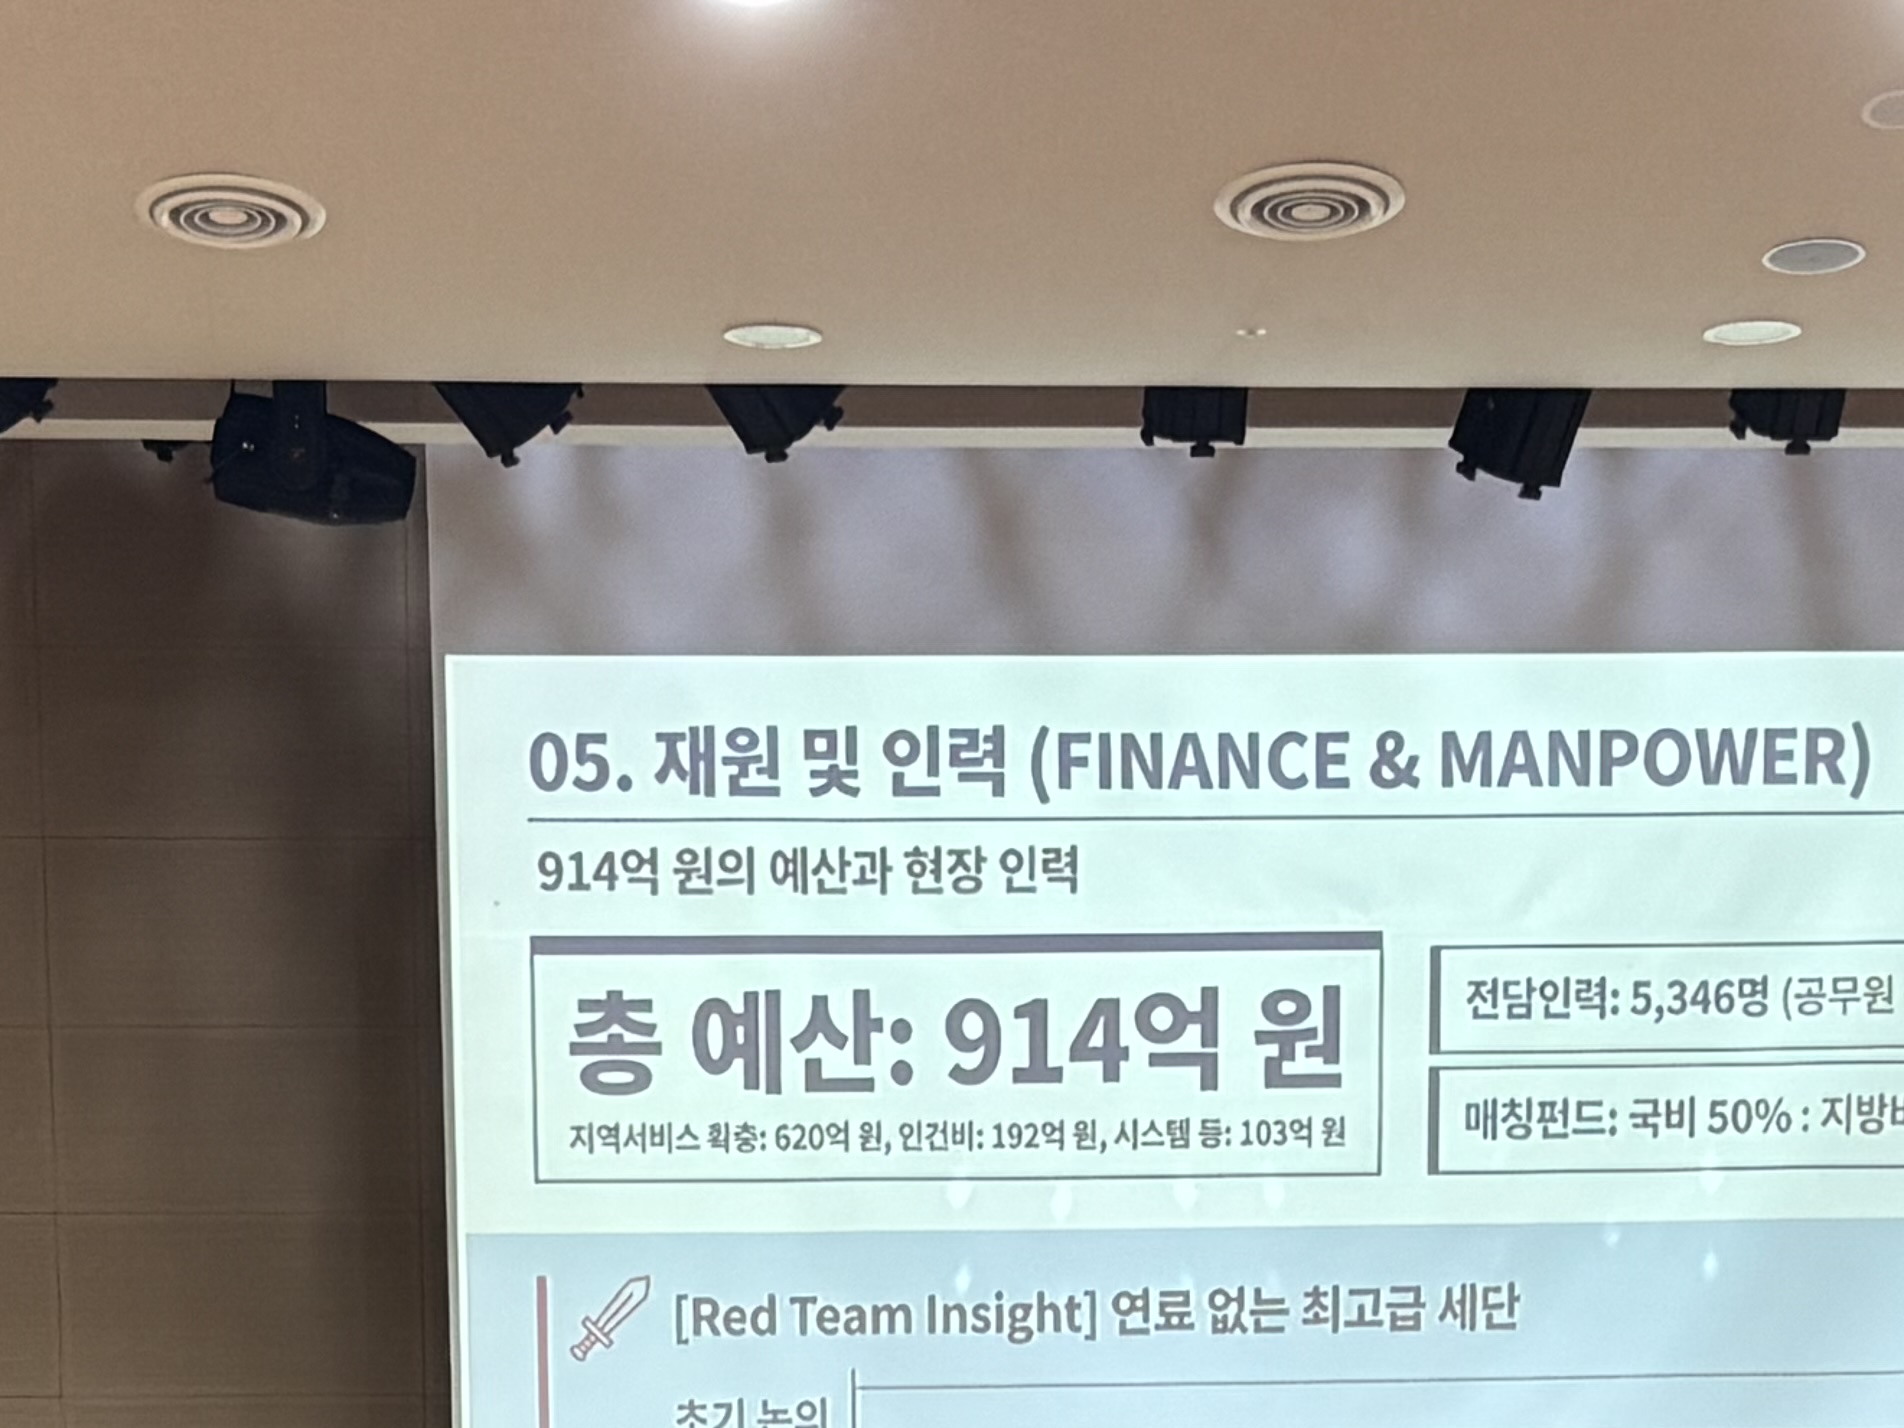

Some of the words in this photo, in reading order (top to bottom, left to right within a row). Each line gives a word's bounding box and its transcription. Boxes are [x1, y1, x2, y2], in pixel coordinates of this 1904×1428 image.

[529, 731, 633, 793] 05.
[653, 724, 782, 799] 재원
[803, 724, 861, 799] 및
[882, 724, 1006, 798] 인력
[1030, 724, 1351, 805] (FINANCE
[1369, 729, 1421, 790] &
[1441, 720, 1871, 800] MANPOWER)
[537, 846, 659, 897] 914억
[672, 845, 755, 896] 원의
[769, 845, 894, 896] 예산과
[903, 845, 988, 896] 현장
[998, 844, 1078, 895] 인력
[1466, 975, 1620, 1021] 전담인력:
[1630, 974, 1769, 1025] 5,346명
[1782, 973, 1895, 1022] (공무원
[568, 989, 663, 1096] 총
[691, 988, 914, 1096] 예산:
[944, 985, 1219, 1092] 914억
[1253, 984, 1343, 1090] 원
[569, 1121, 701, 1155] 지역서비스
[774, 1119, 850, 1153] 620억
[858, 1119, 892, 1156] 원,
[898, 1119, 984, 1153] 인건비:
[992, 1118, 1065, 1152] 192억
[1072, 1118, 1108, 1155] 원,
[1113, 1117, 1191, 1151] 시스템
[1198, 1118, 1232, 1149] 등:
[1240, 1115, 1313, 1149] 103억
[1321, 1115, 1346, 1148] 원
[1465, 1096, 1618, 1141] 매칭펀드:
[1628, 1095, 1696, 1139] 국비
[1707, 1096, 1793, 1135] 50%
[675, 1292, 777, 1346] [Red
[788, 1295, 913, 1337] Team
[927, 1289, 1097, 1345] Insight]
[1111, 1286, 1196, 1337] 연료
[1207, 1284, 1291, 1335] 없는
[1301, 1283, 1427, 1335] 최고급
[1437, 1282, 1521, 1333] 세단
